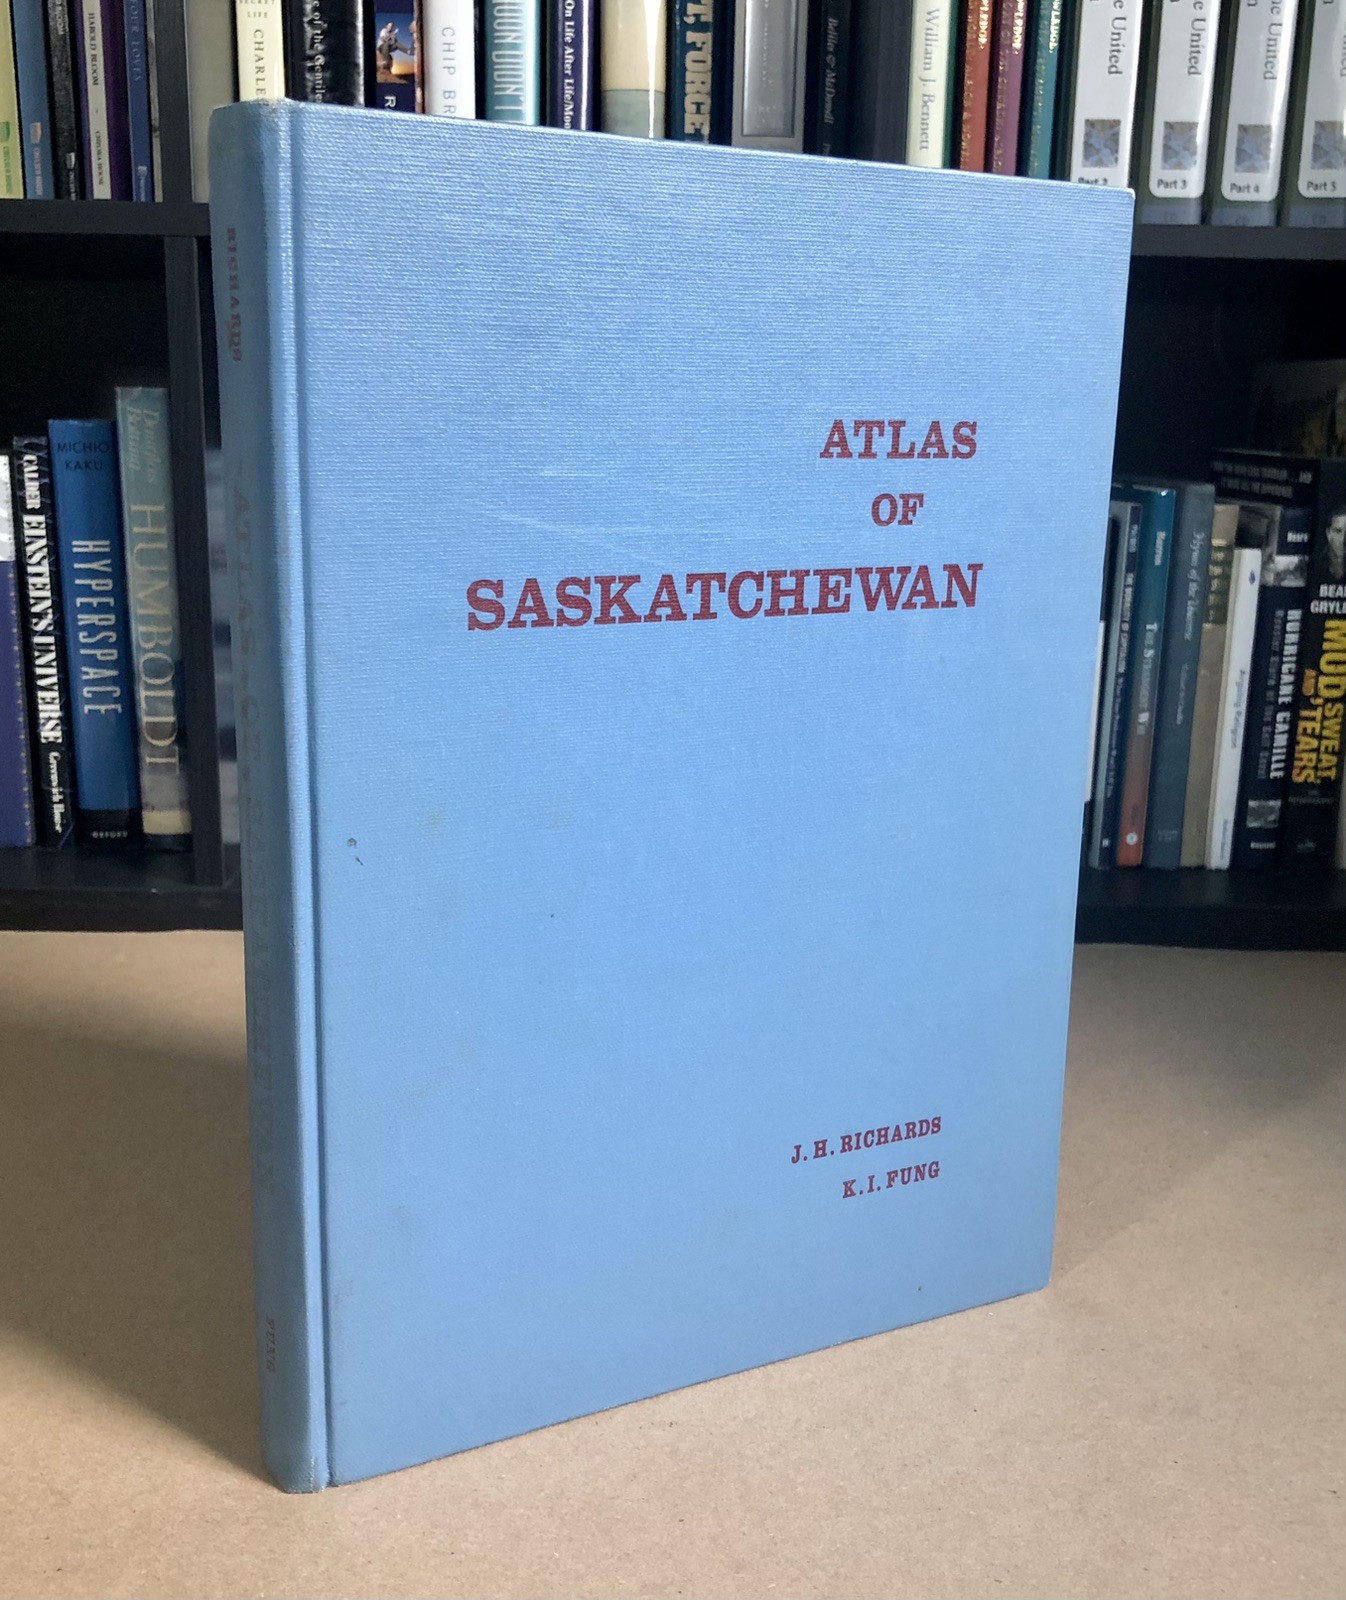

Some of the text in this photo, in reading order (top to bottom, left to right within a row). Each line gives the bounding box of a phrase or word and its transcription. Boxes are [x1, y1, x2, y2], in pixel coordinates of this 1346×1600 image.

[314, 27, 323, 43] the
[564, 0, 575, 18] On
[564, 21, 576, 44] Life
[88, 12, 99, 86] HAROLD BLOOM
[131, 40, 141, 82] LOVES
[253, 28, 267, 101] CHARLE
[442, 26, 456, 76] CHIP
[564, 45, 576, 77] After
[1107, 16, 1127, 75] United
[1187, 18, 1207, 77] United
[1263, 22, 1282, 80] United
[493, 50, 525, 112] DIDN'T
[684, 31, 714, 134] FORCE
[823, 69, 837, 124] McDowell
[918, 7, 940, 152] William J. Bennett
[1157, 179, 1178, 190] Part
[1230, 183, 1250, 194] Part
[1307, 181, 1326, 192] Part
[57, 440, 110, 454] MICHIO
[65, 460, 104, 472] KAKU
[819, 418, 978, 460] ATLAS
[23, 454, 41, 510] CALDER
[871, 492, 925, 527] OF
[22, 513, 54, 631] EINSTEIN'S
[466, 563, 984, 631] SASKATCHEWAN
[1319, 583, 1346, 598] BEA
[71, 539, 123, 715] HYPERSPACE
[129, 504, 181, 776] HUMBOLDT
[32, 635, 63, 744] UNIVERSE
[1269, 609, 1303, 779] HURRICANE CAMILLE
[1292, 707, 1323, 783] TEARS
[840, 1116, 941, 1153] RICHARDS
[886, 1160, 940, 1188] FUNG
